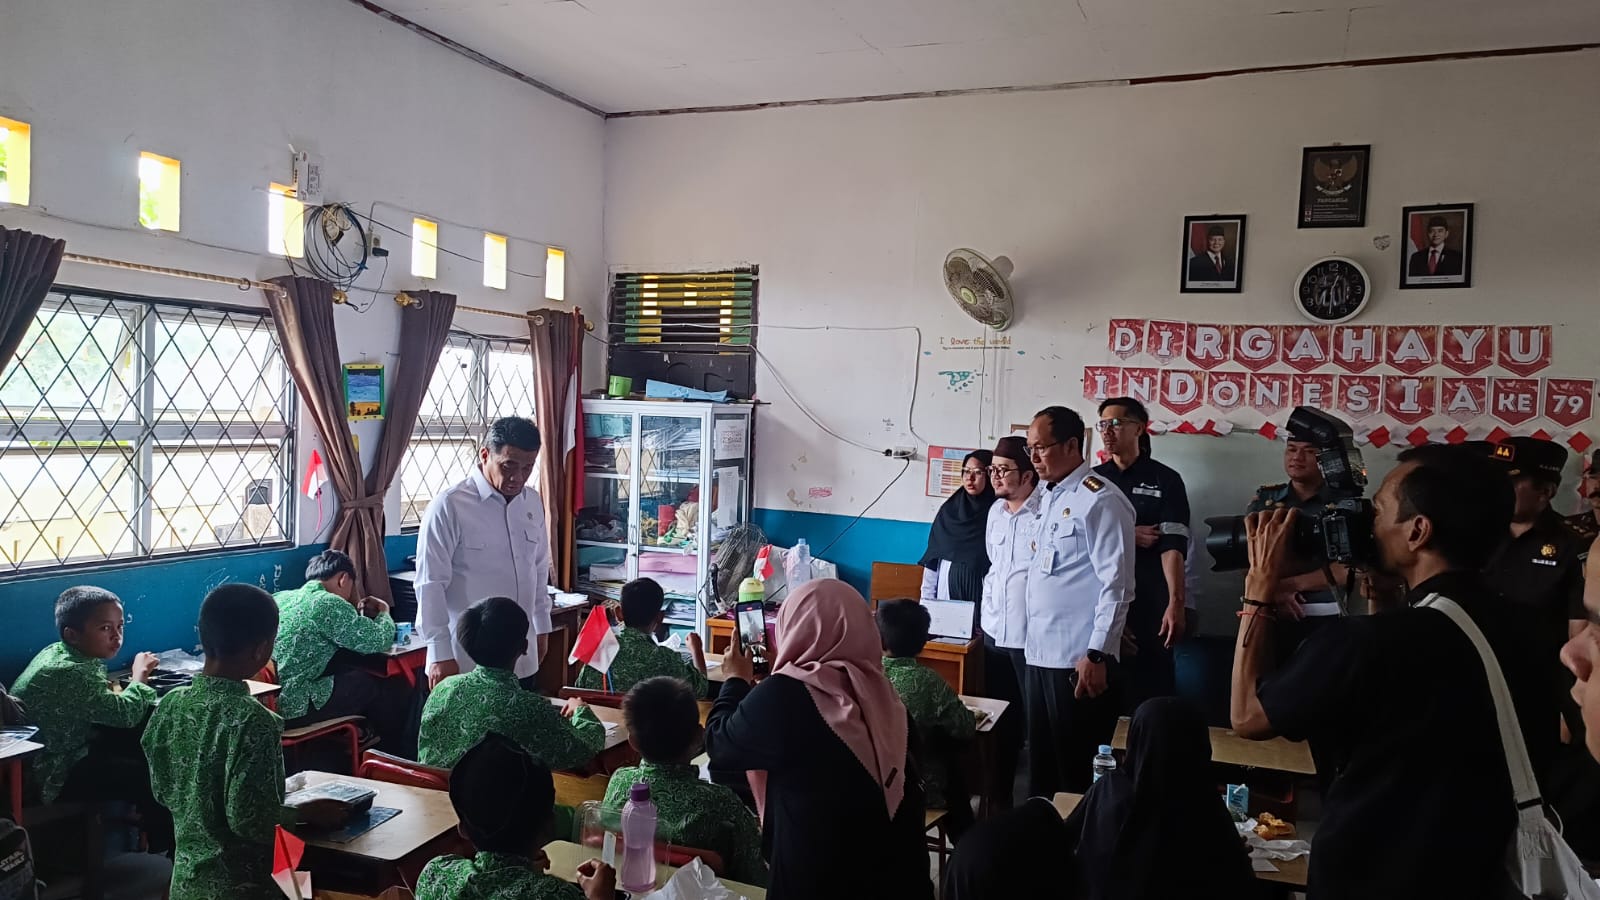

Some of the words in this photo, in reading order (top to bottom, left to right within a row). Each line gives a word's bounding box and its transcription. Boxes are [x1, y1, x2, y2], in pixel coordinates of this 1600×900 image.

[1114, 326, 1541, 364] DIRGAHAYU
[1096, 372, 1483, 413] INDONESIA
[1499, 392, 1532, 413] KE
[1553, 394, 1584, 415] 79
